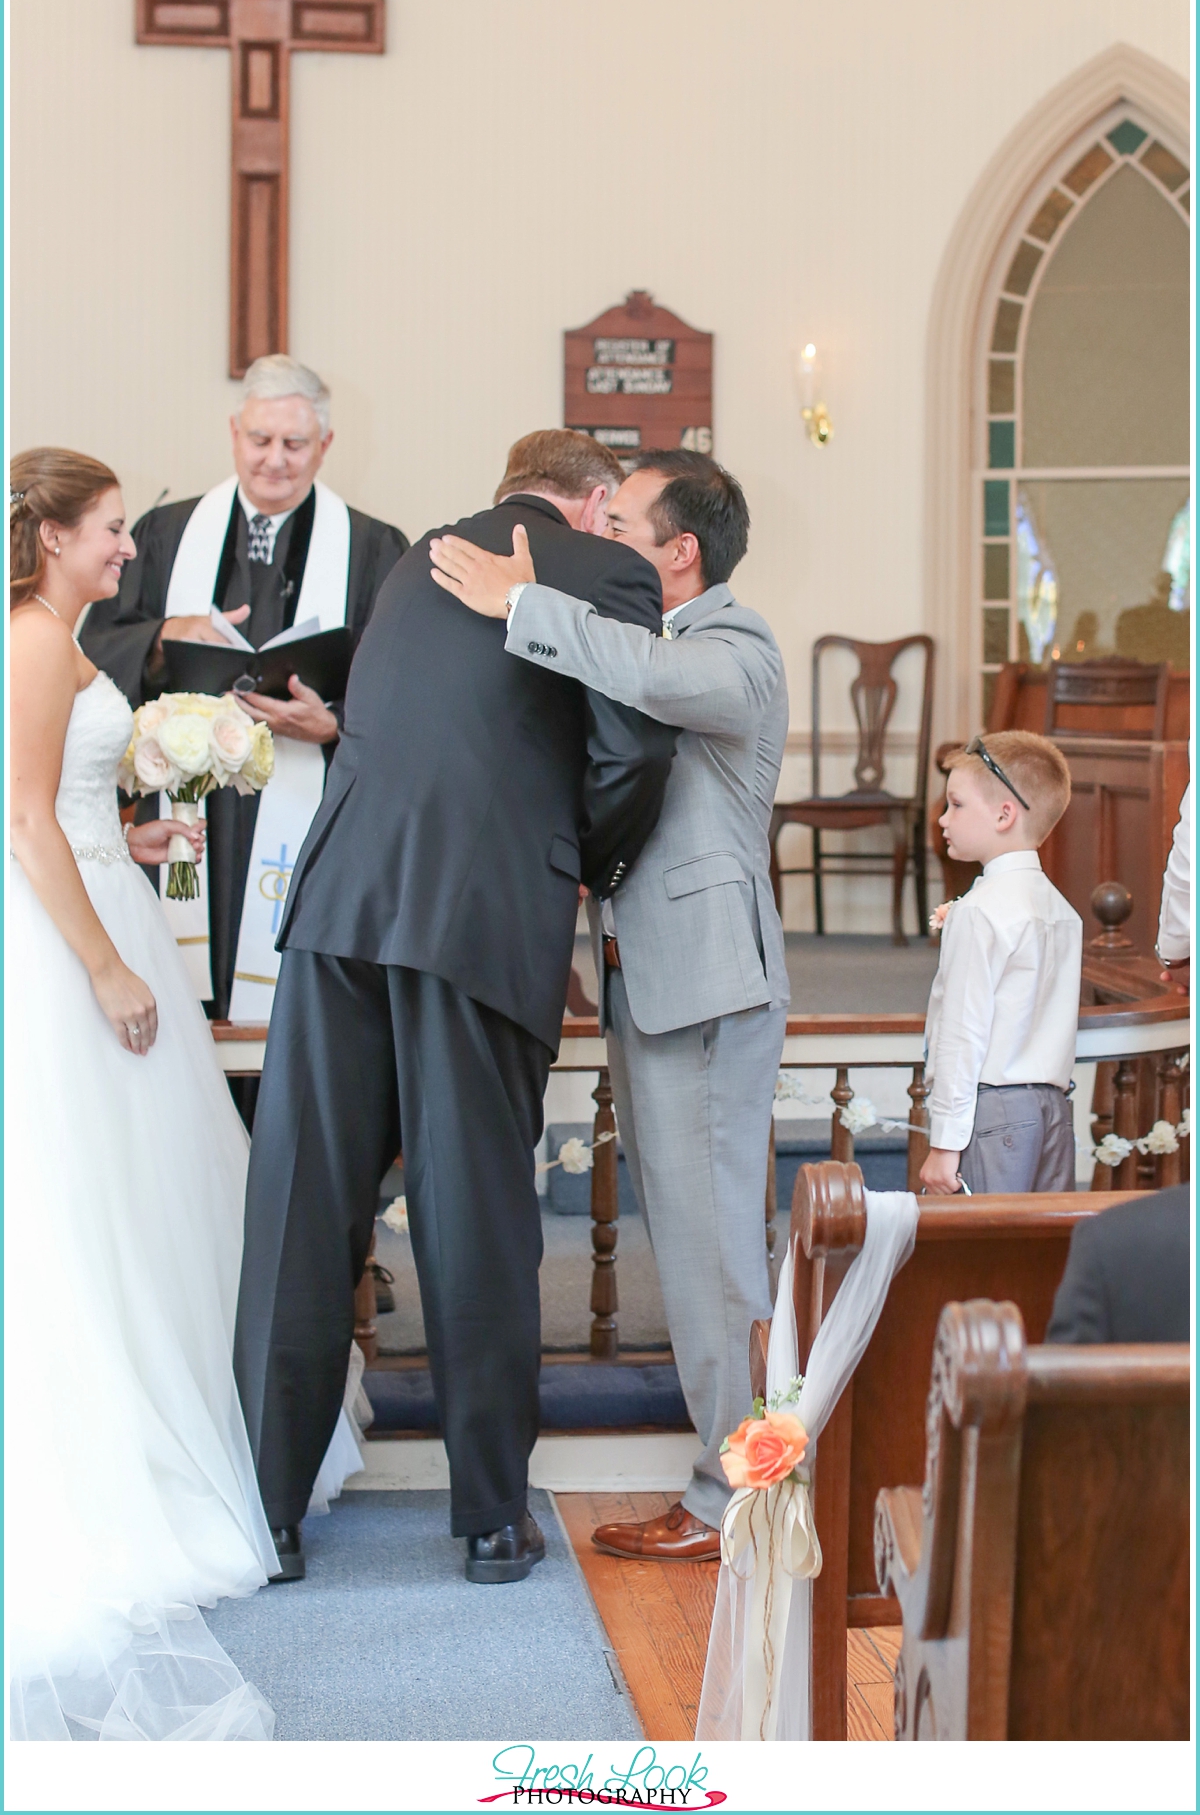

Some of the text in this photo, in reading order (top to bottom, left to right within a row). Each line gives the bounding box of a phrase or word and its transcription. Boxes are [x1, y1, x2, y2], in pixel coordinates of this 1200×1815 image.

[595, 339, 649, 351] REGISTER
[596, 352, 667, 364] ATTENDANCE
[587, 366, 664, 379] ATTENDANCE
[587, 380, 672, 393] LAST SUNDAY
[681, 427, 712, 452] 46
